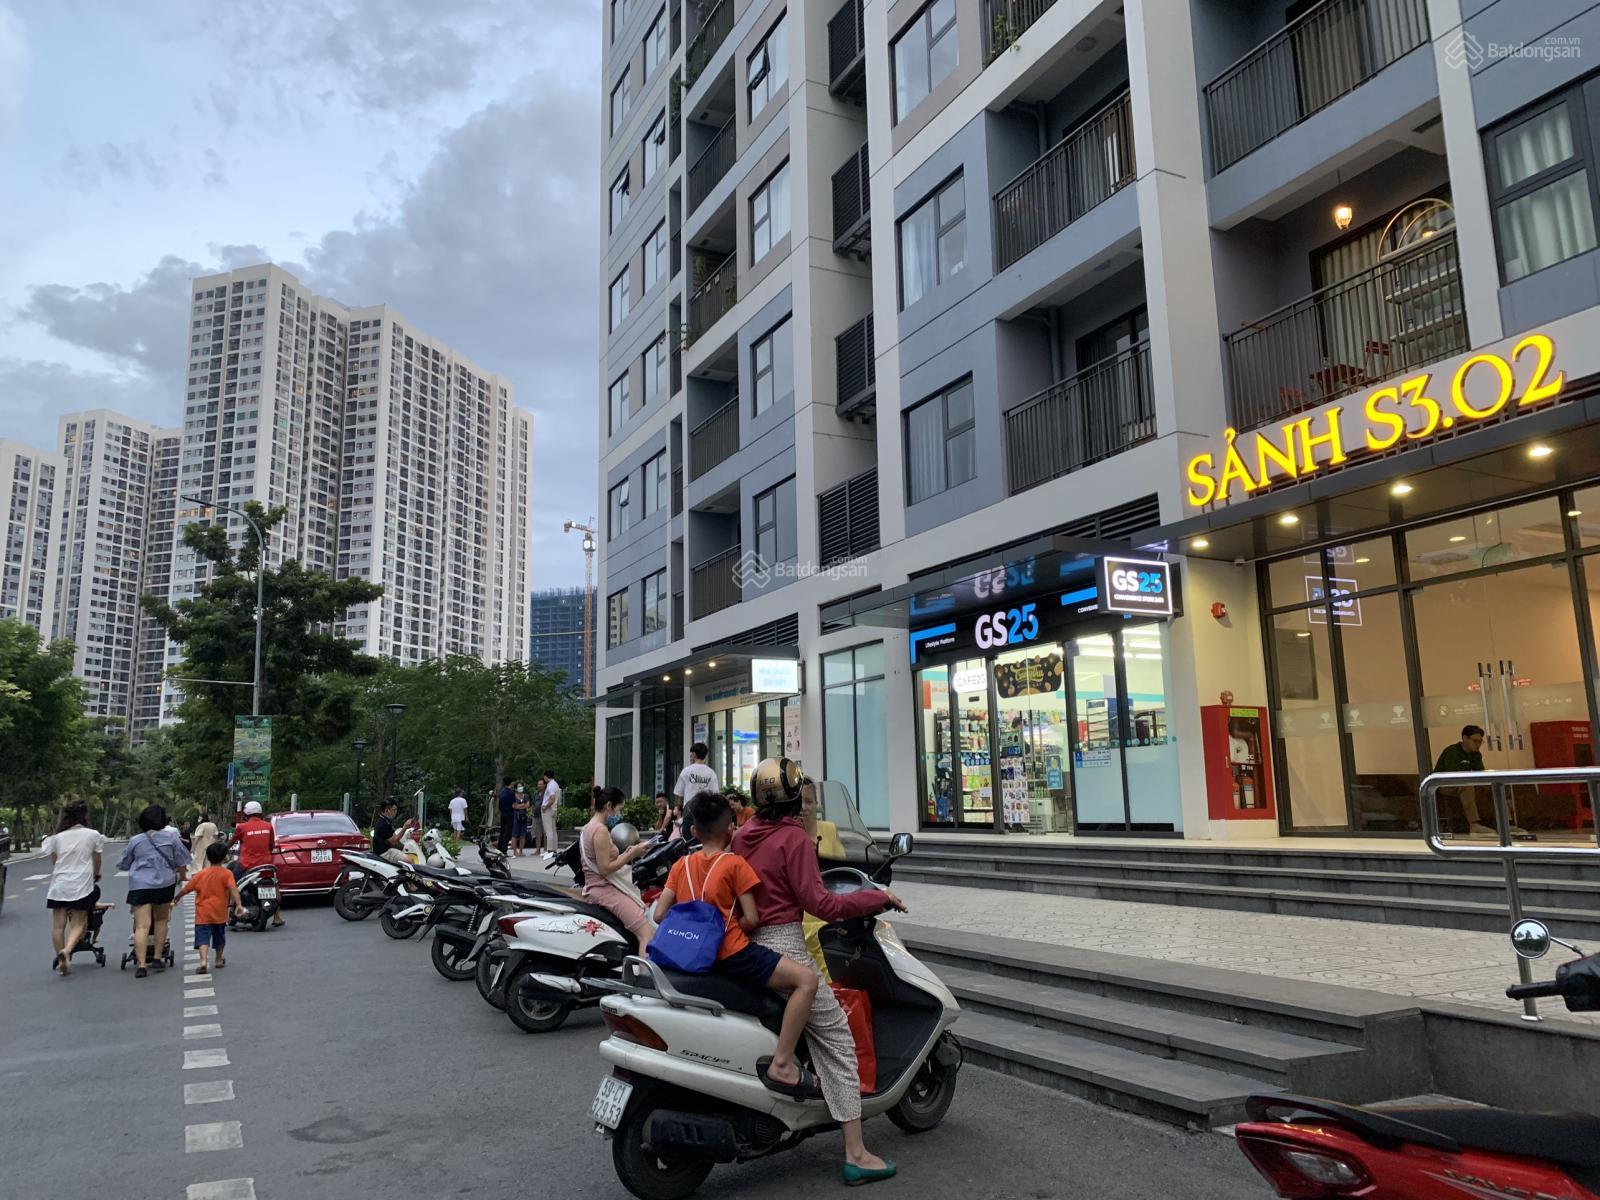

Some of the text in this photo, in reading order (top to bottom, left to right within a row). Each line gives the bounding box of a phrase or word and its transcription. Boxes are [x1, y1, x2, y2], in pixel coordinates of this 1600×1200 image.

[1186, 406, 1347, 507] SẢNH
[1112, 569, 1163, 593] GS25
[975, 602, 1039, 649] GS25
[667, 928, 700, 940] KUMON
